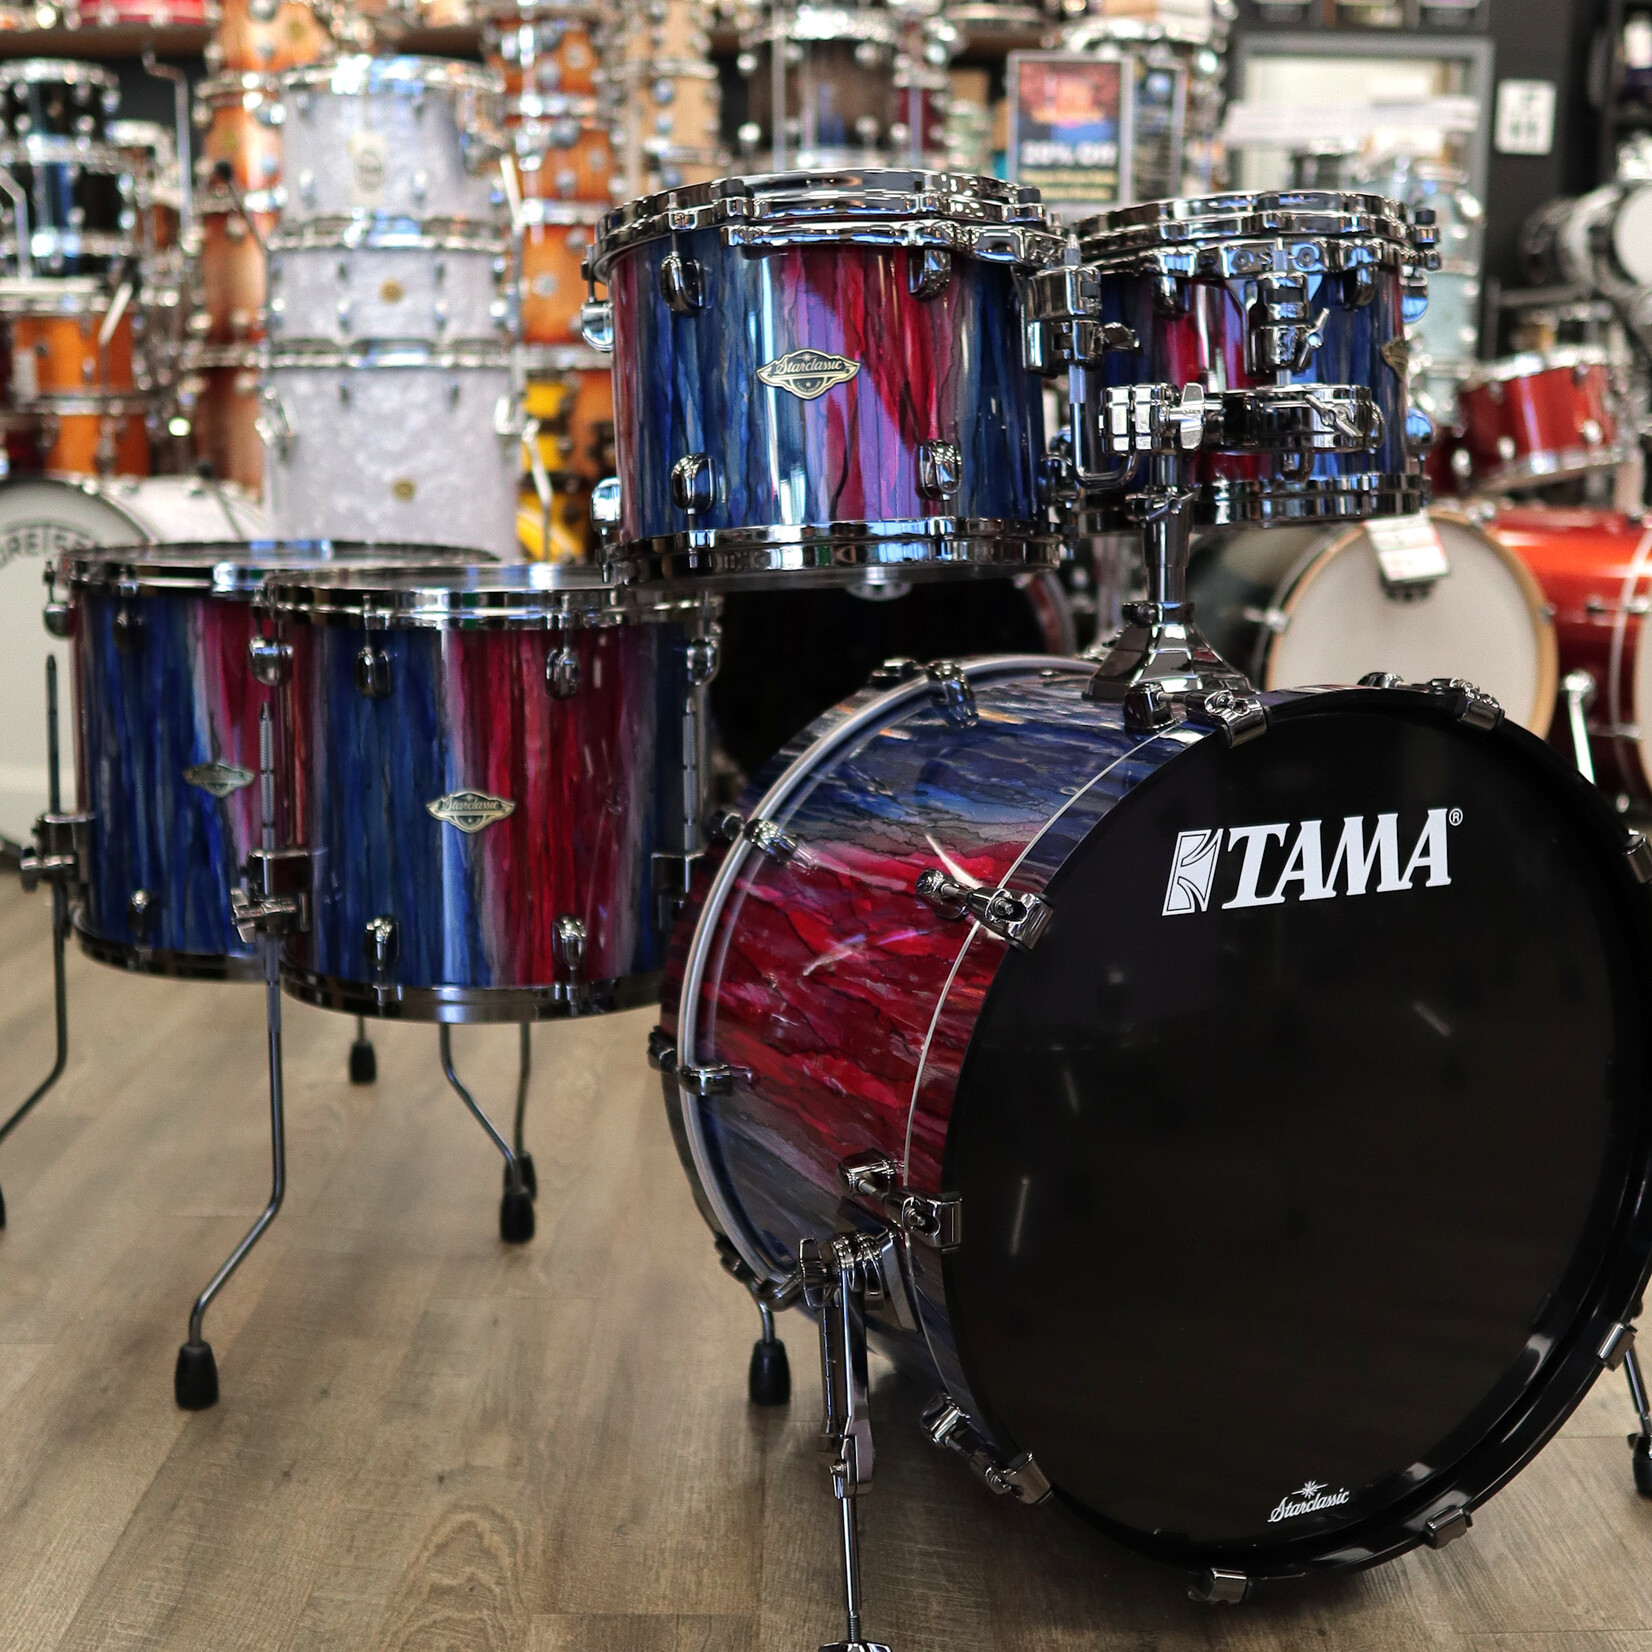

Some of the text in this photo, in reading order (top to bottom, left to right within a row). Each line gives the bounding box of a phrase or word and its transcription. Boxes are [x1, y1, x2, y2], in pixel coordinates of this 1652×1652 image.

[773, 357, 842, 375] Starclassic
[442, 795, 499, 811] Starclassic
[1267, 1487, 1350, 1522] Starclassic
